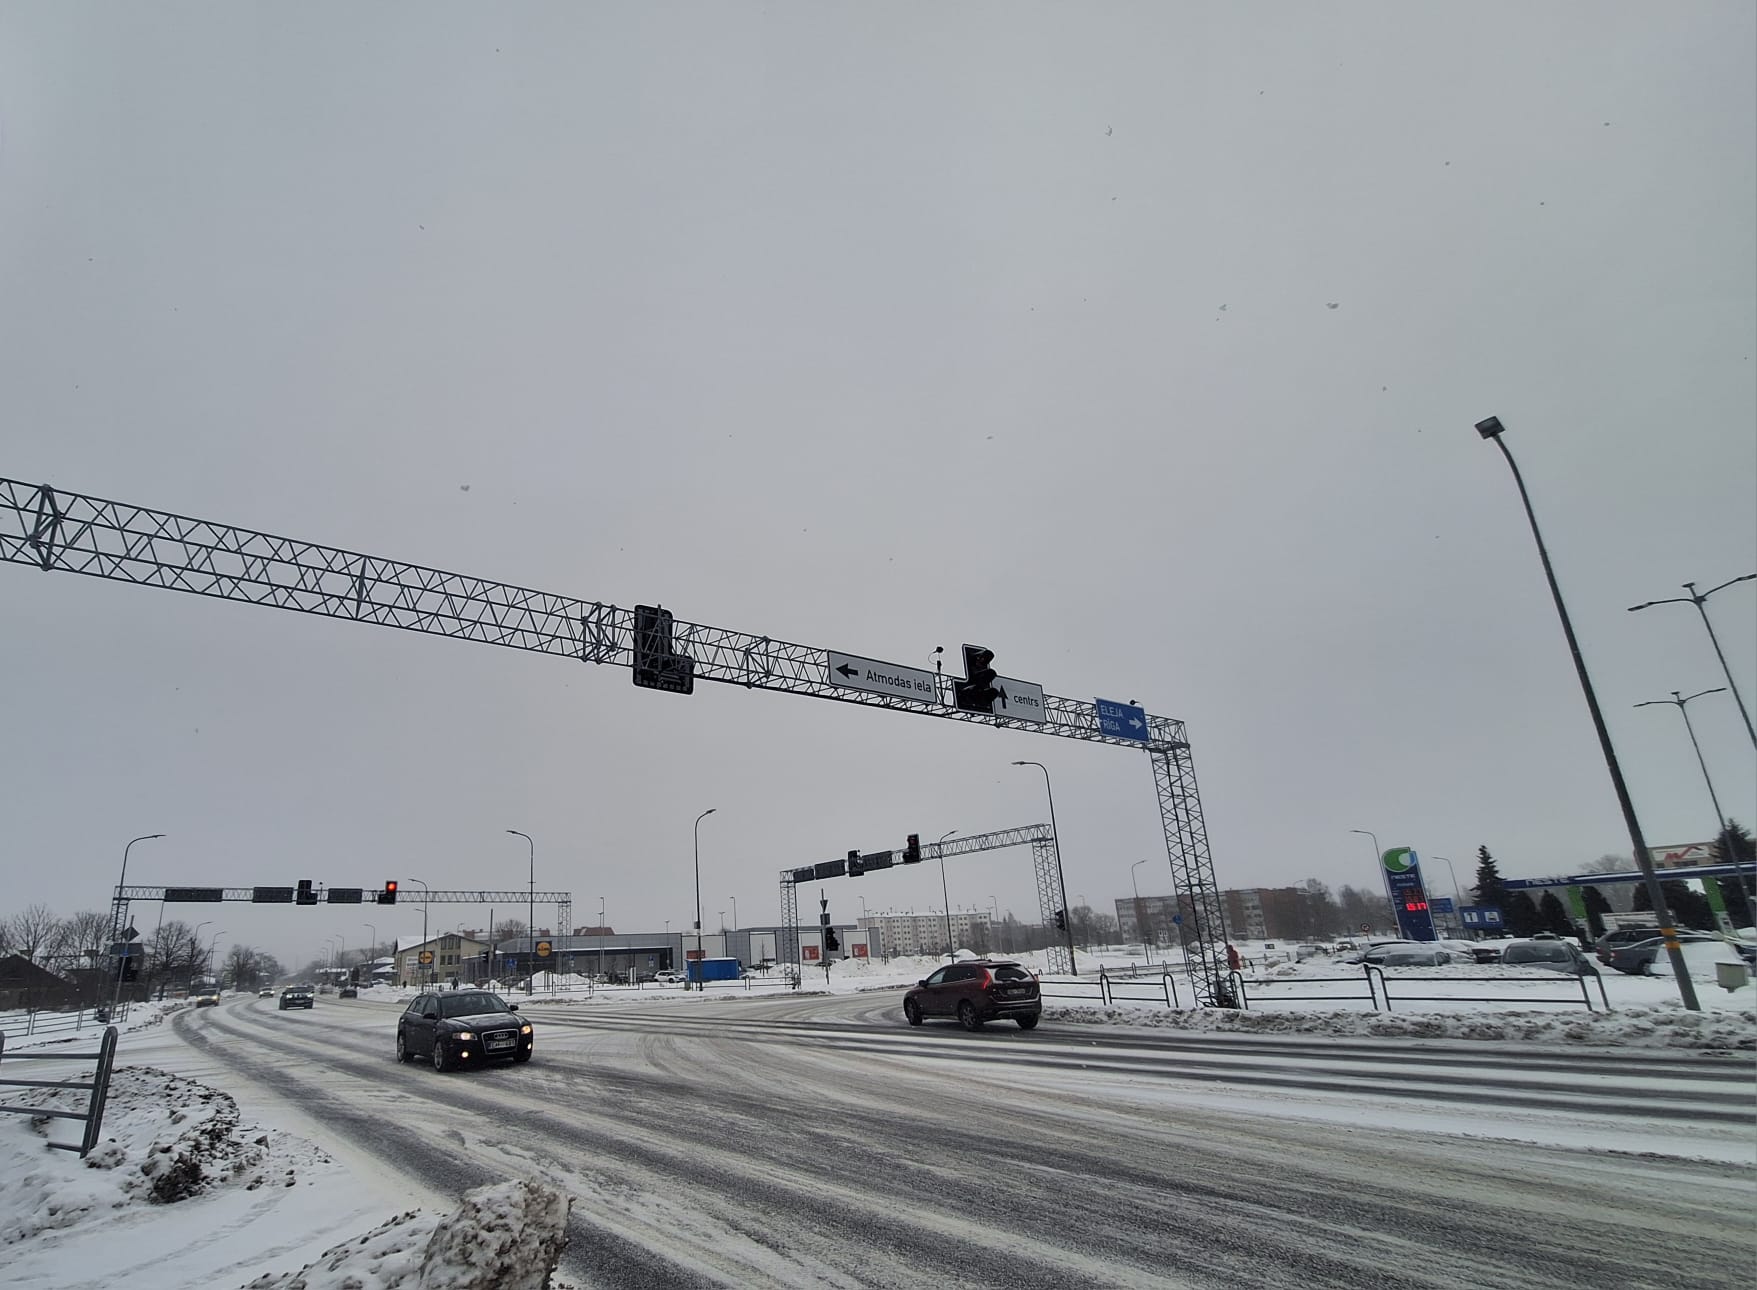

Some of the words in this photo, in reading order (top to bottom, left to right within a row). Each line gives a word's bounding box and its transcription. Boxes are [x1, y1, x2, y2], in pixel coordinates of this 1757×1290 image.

[866, 669, 912, 689] Atmodas
[914, 678, 932, 693] iela
[1013, 695, 1039, 707] centrs
[1101, 704, 1125, 719] ELEJA
